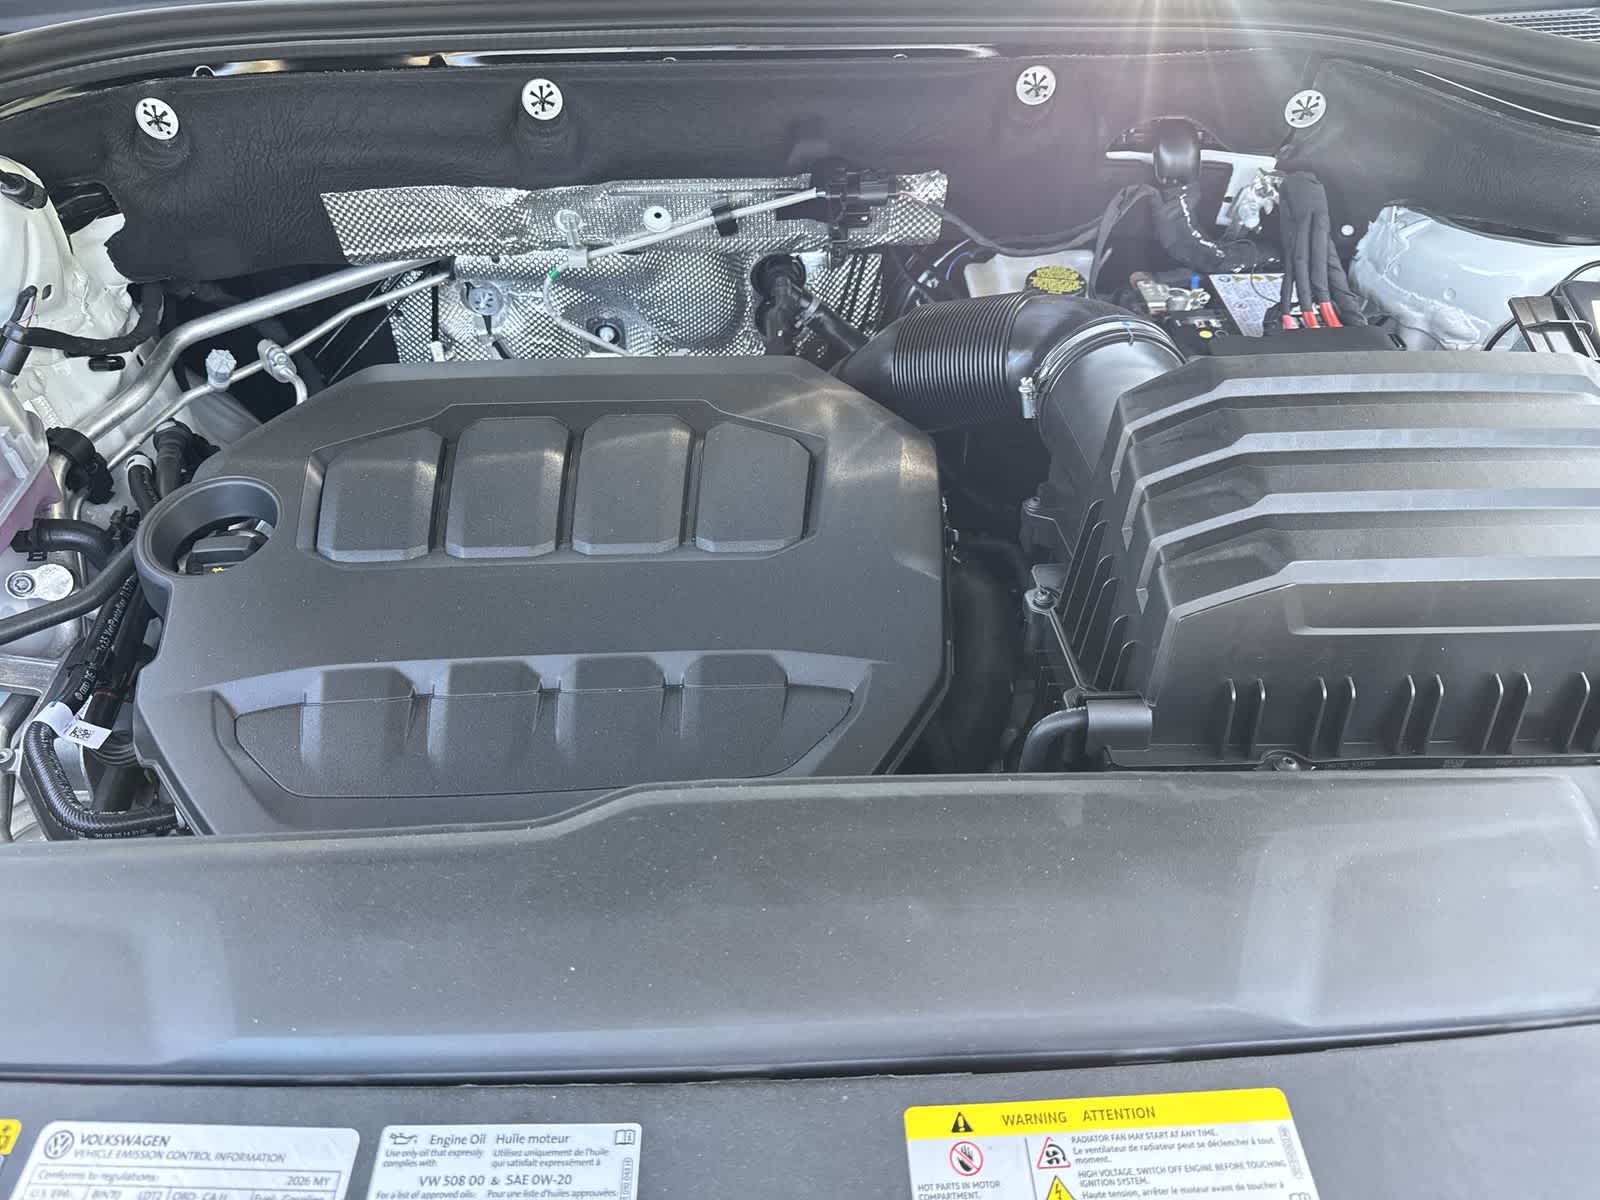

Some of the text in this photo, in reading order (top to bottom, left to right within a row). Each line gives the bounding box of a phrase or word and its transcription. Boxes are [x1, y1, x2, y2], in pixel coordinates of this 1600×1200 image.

[1002, 1106, 1156, 1127] WARNING ATTENTION
[80, 1134, 171, 1147] VOLKSWAGEN
[430, 1133, 486, 1148] Engine Oil
[496, 1133, 570, 1144] Huile moteur
[1071, 1134, 1110, 1144] RADIATOR
[1111, 1133, 1126, 1142] FAN
[1127, 1132, 1145, 1141] MAY
[1145, 1130, 1168, 1140] START
[431, 1149, 446, 1157] that
[574, 1148, 584, 1156] de
[1084, 1145, 1127, 1154] ventilateur
[1128, 1144, 1138, 1152] de
[1140, 1143, 1175, 1152] radiateur
[115, 1149, 163, 1160] EMISSION
[166, 1150, 213, 1162] CONTROL
[215, 1152, 286, 1163] INFORMATION
[505, 1158, 538, 1167] satisfait
[1078, 1168, 1098, 1178] HIGH
[1136, 1166, 1166, 1175] SWITCH
[1168, 1165, 1182, 1173] OFF
[1184, 1163, 1213, 1172] ENGINE
[1215, 1161, 1245, 1171] BEFORE
[1246, 1160, 1287, 1169] TOUCHING
[287, 1175, 330, 1186] 2026 MY
[419, 1174, 573, 1187] VW 508 00 & SAE 0W-20
[918, 1180, 1000, 1191] HOT PARTS IN MOTOR
[1080, 1179, 1115, 1188] IGNITION
[488, 1189, 505, 1198] Pour
[507, 1190, 522, 1198] une
[918, 1191, 982, 1200] COMPARTMENT.
[1082, 1190, 1107, 1200] Haute
[1170, 1185, 1178, 1195] le
